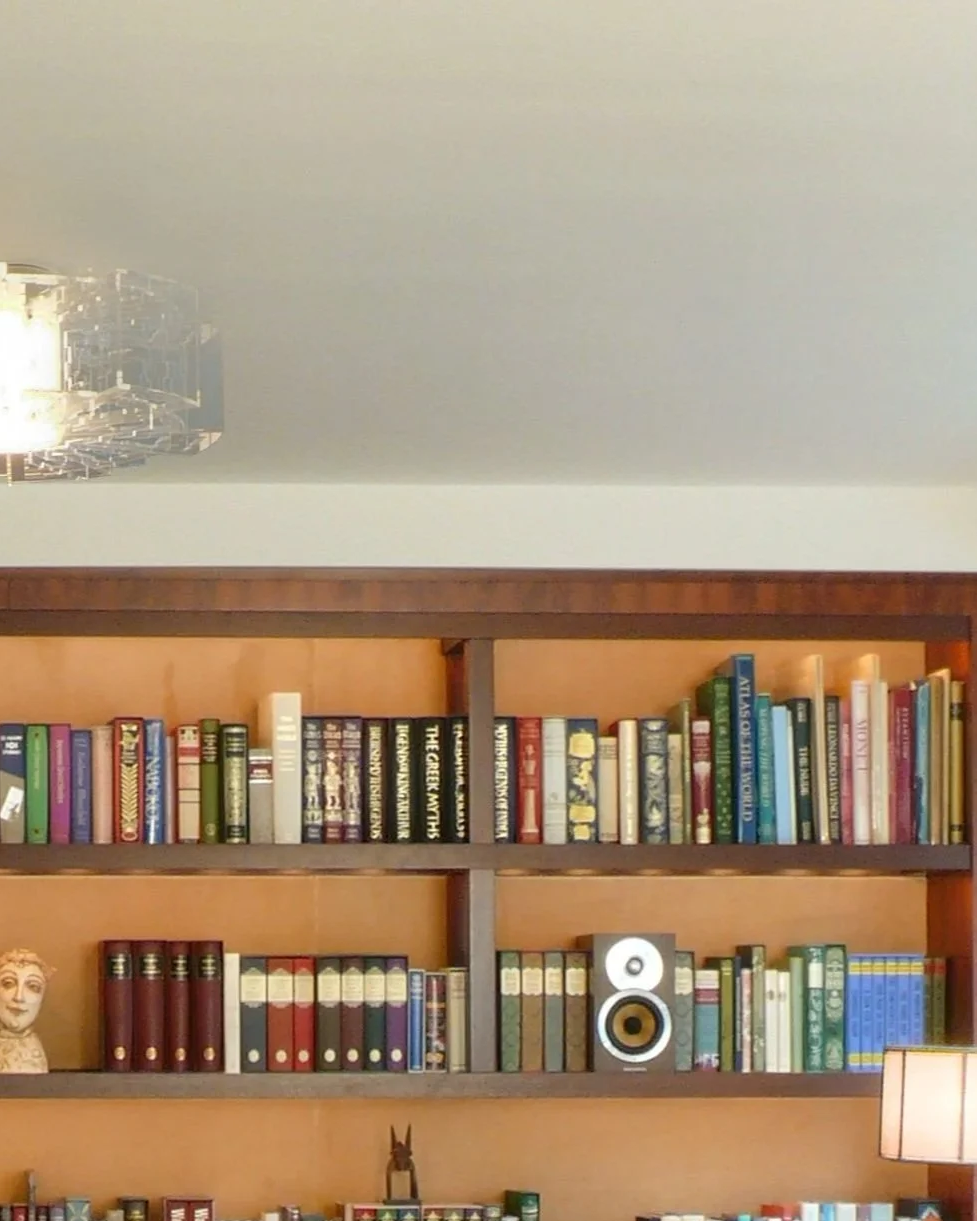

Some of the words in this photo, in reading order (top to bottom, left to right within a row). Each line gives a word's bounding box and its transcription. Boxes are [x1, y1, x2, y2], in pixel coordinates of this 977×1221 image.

[739, 676, 750, 719] ATLAS
[427, 725, 439, 752] THE
[740, 721, 751, 738] OF
[856, 719, 868, 773] MONET
[741, 741, 752, 768] THE
[798, 747, 809, 768] THE
[828, 724, 839, 776] LEONARDO
[396, 773, 410, 797] KING
[427, 753, 439, 791] GREEK
[800, 769, 811, 797] NUDE
[742, 771, 753, 822] WORLD
[830, 790, 840, 820] VINCI
[396, 798, 410, 839] ARTHUR
[427, 793, 439, 840] MYTHS
